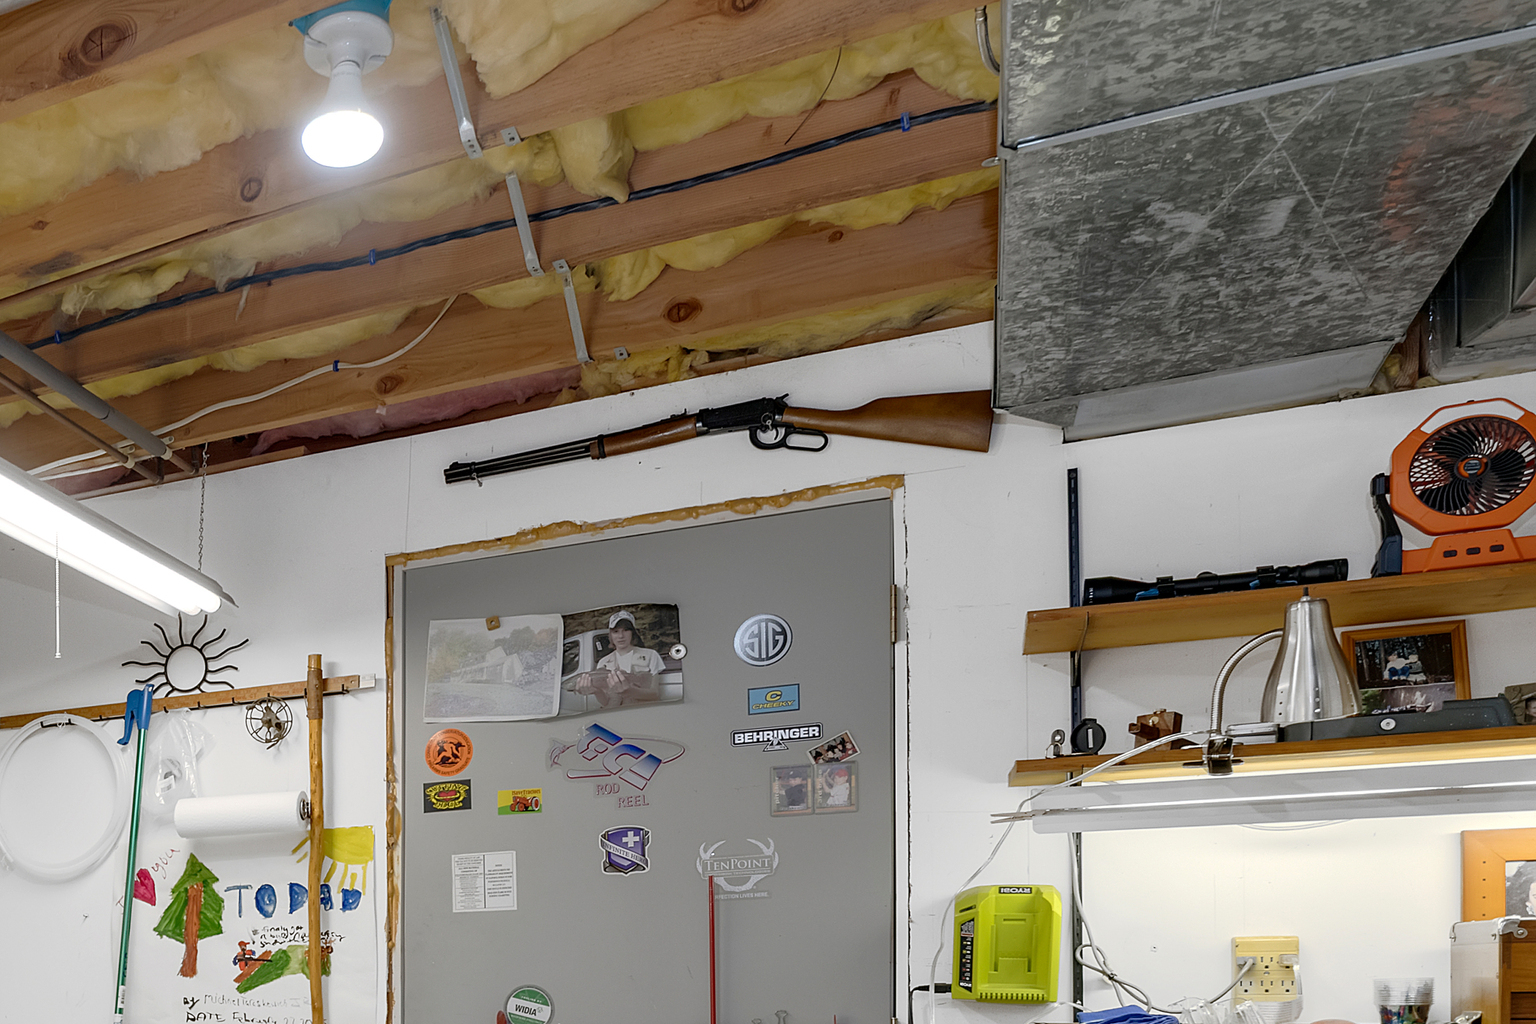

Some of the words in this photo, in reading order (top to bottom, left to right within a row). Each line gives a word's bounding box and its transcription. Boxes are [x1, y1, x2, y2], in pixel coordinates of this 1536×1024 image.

[744, 622, 784, 658] SIG
[752, 700, 795, 710] CHEEKY
[734, 726, 820, 744] BEHRINGER
[595, 783, 620, 796] ROD
[618, 795, 650, 809] REEL
[151, 849, 181, 880] you
[515, 1004, 537, 1016] WIDIA
[186, 1012, 225, 1023] DATE
